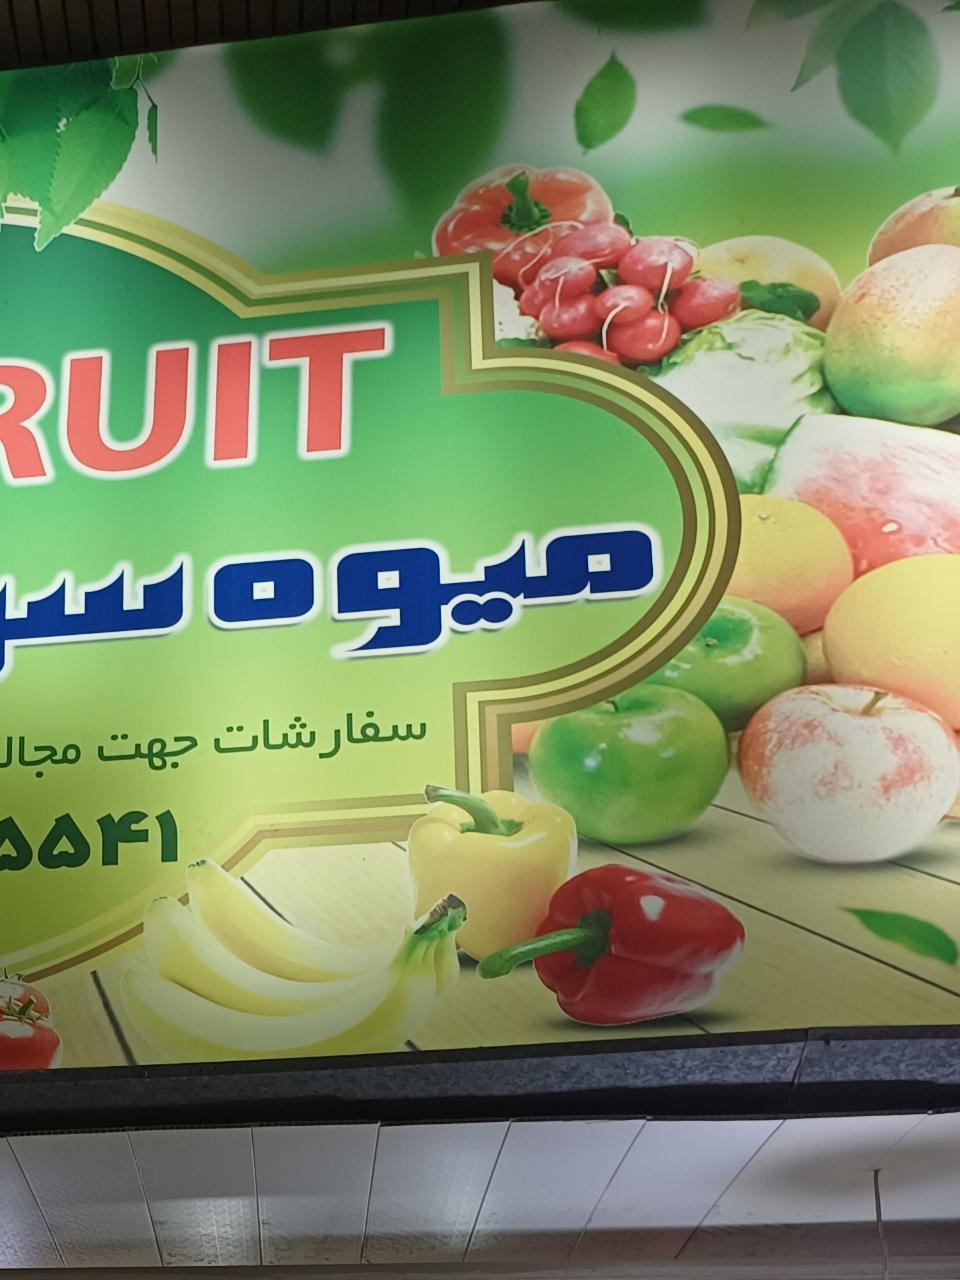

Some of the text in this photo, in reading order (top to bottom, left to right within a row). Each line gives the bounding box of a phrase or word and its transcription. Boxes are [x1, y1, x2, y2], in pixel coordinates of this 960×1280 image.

[210, 527, 658, 657] میوه
[97, 730, 199, 770] جهت
[213, 710, 428, 760] سفارشات
